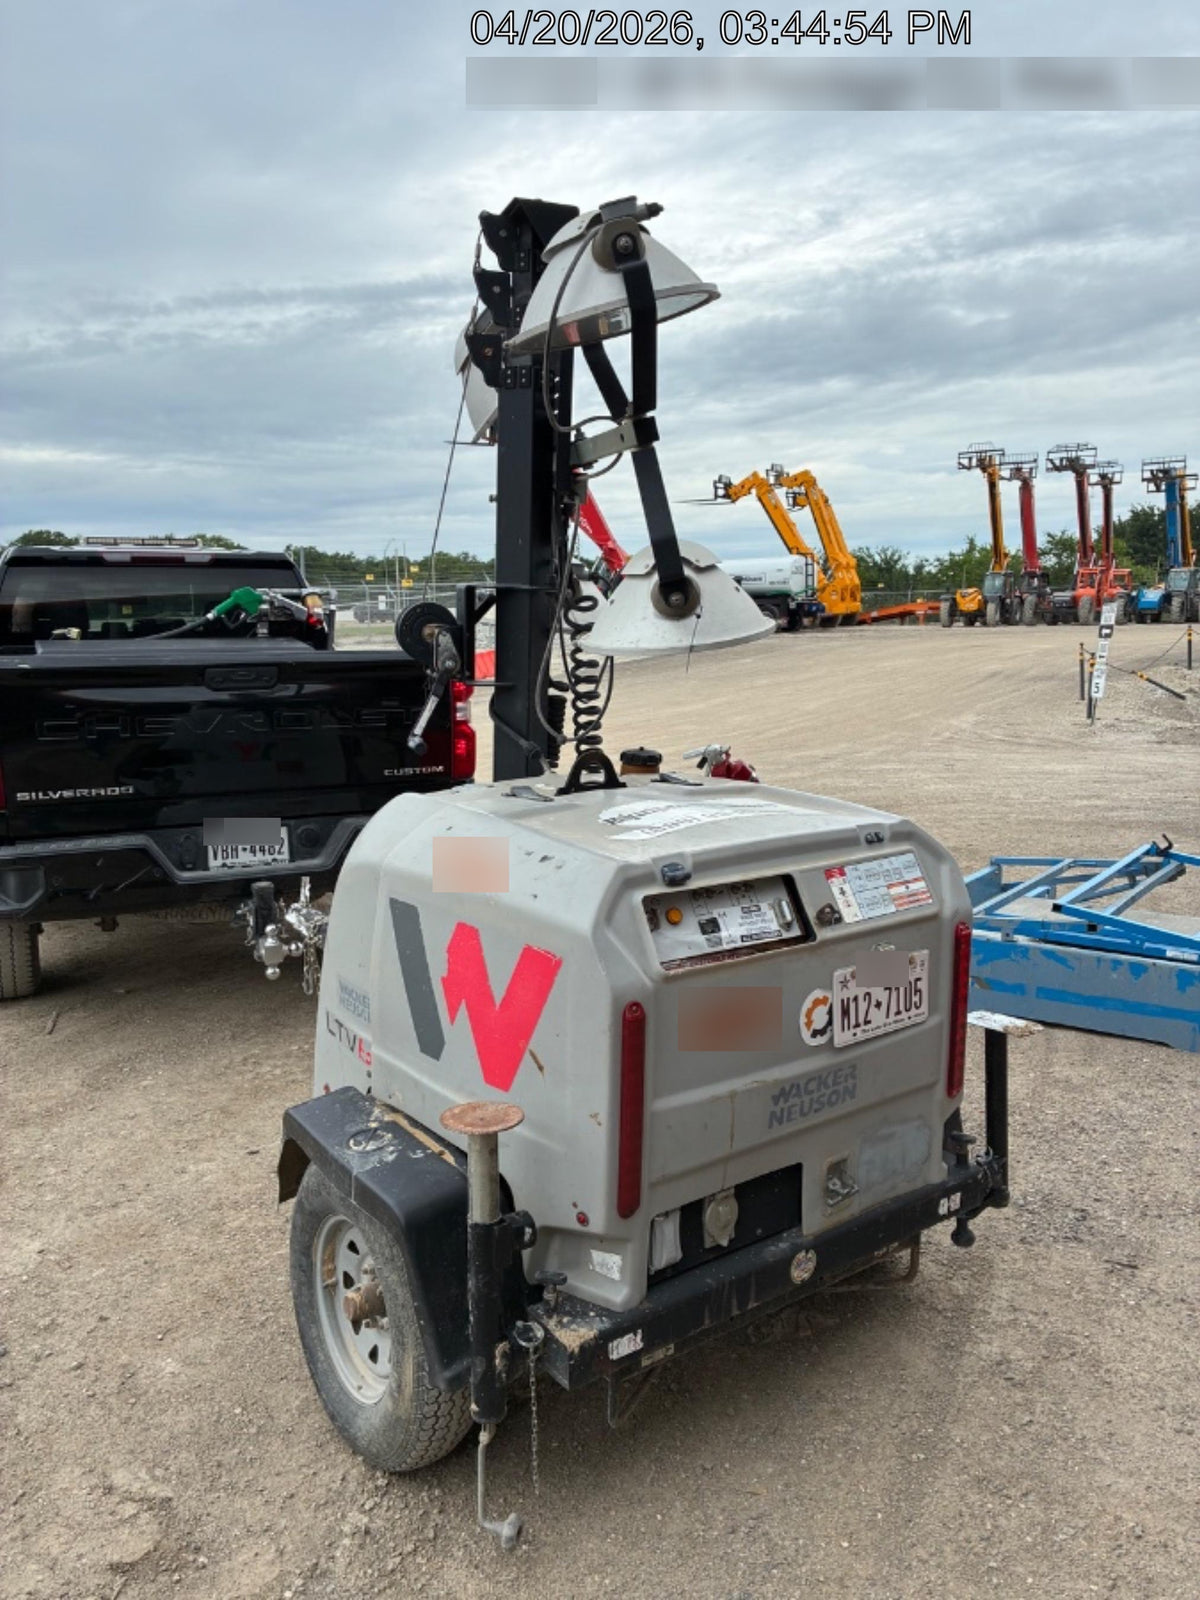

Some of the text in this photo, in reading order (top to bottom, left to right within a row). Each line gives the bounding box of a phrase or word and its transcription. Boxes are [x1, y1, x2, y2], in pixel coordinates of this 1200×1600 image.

[384, 764, 445, 777] CUSTOM
[16, 785, 134, 801] SILVERADO
[770, 1063, 858, 1107] WACKER
[767, 1082, 858, 1130] NEUSON
